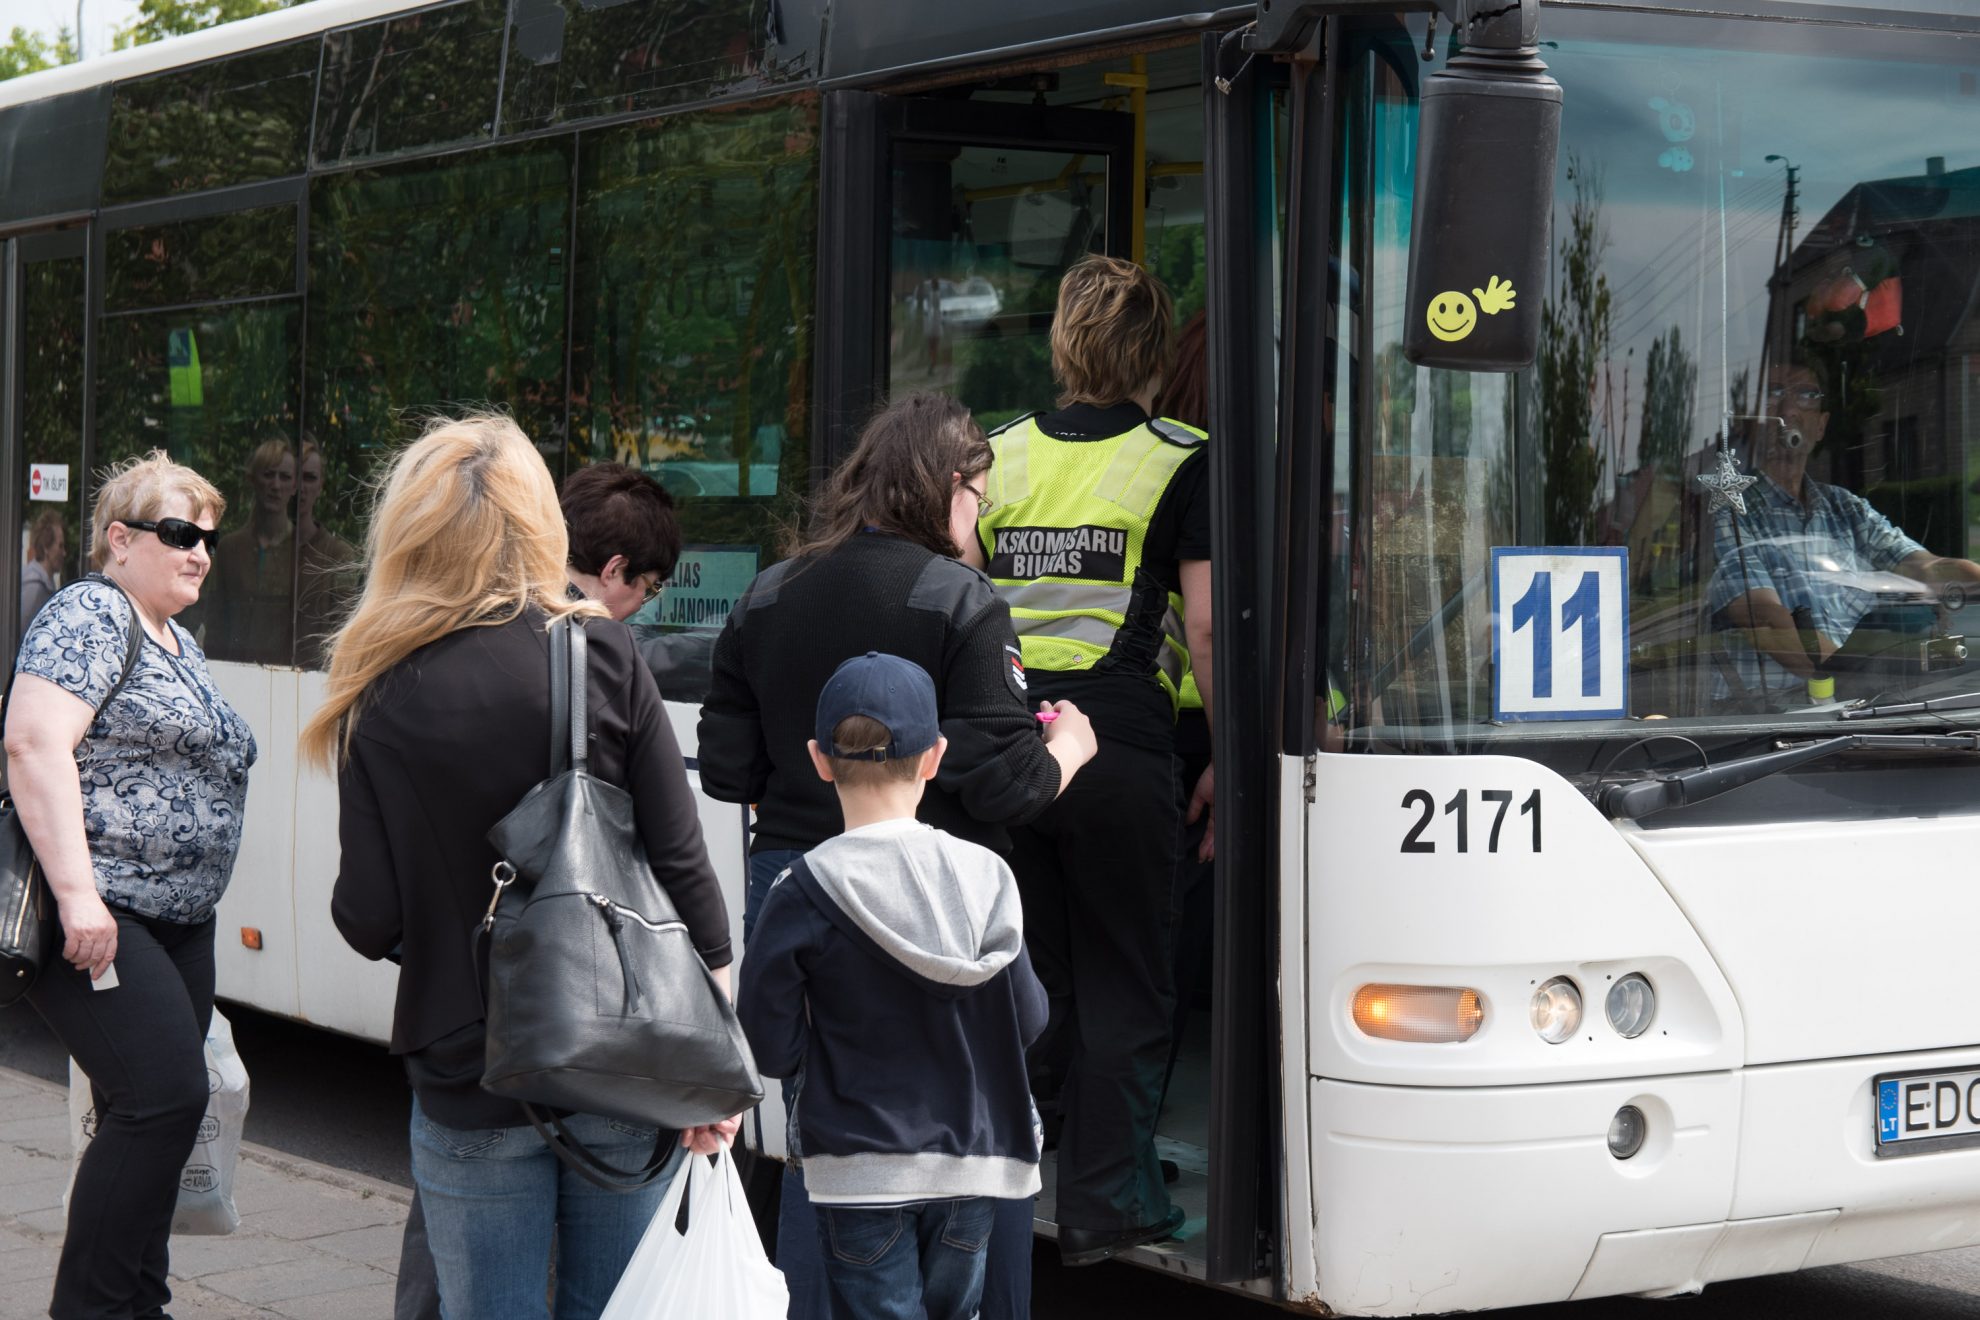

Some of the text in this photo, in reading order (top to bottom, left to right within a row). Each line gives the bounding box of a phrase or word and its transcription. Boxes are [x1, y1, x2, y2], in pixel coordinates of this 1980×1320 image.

[655, 597, 666, 622] J.
[670, 597, 729, 625] JANONIO
[1513, 571, 1601, 698] 11
[1400, 789, 1542, 853] 2171
[1881, 1117, 1898, 1132] LT
